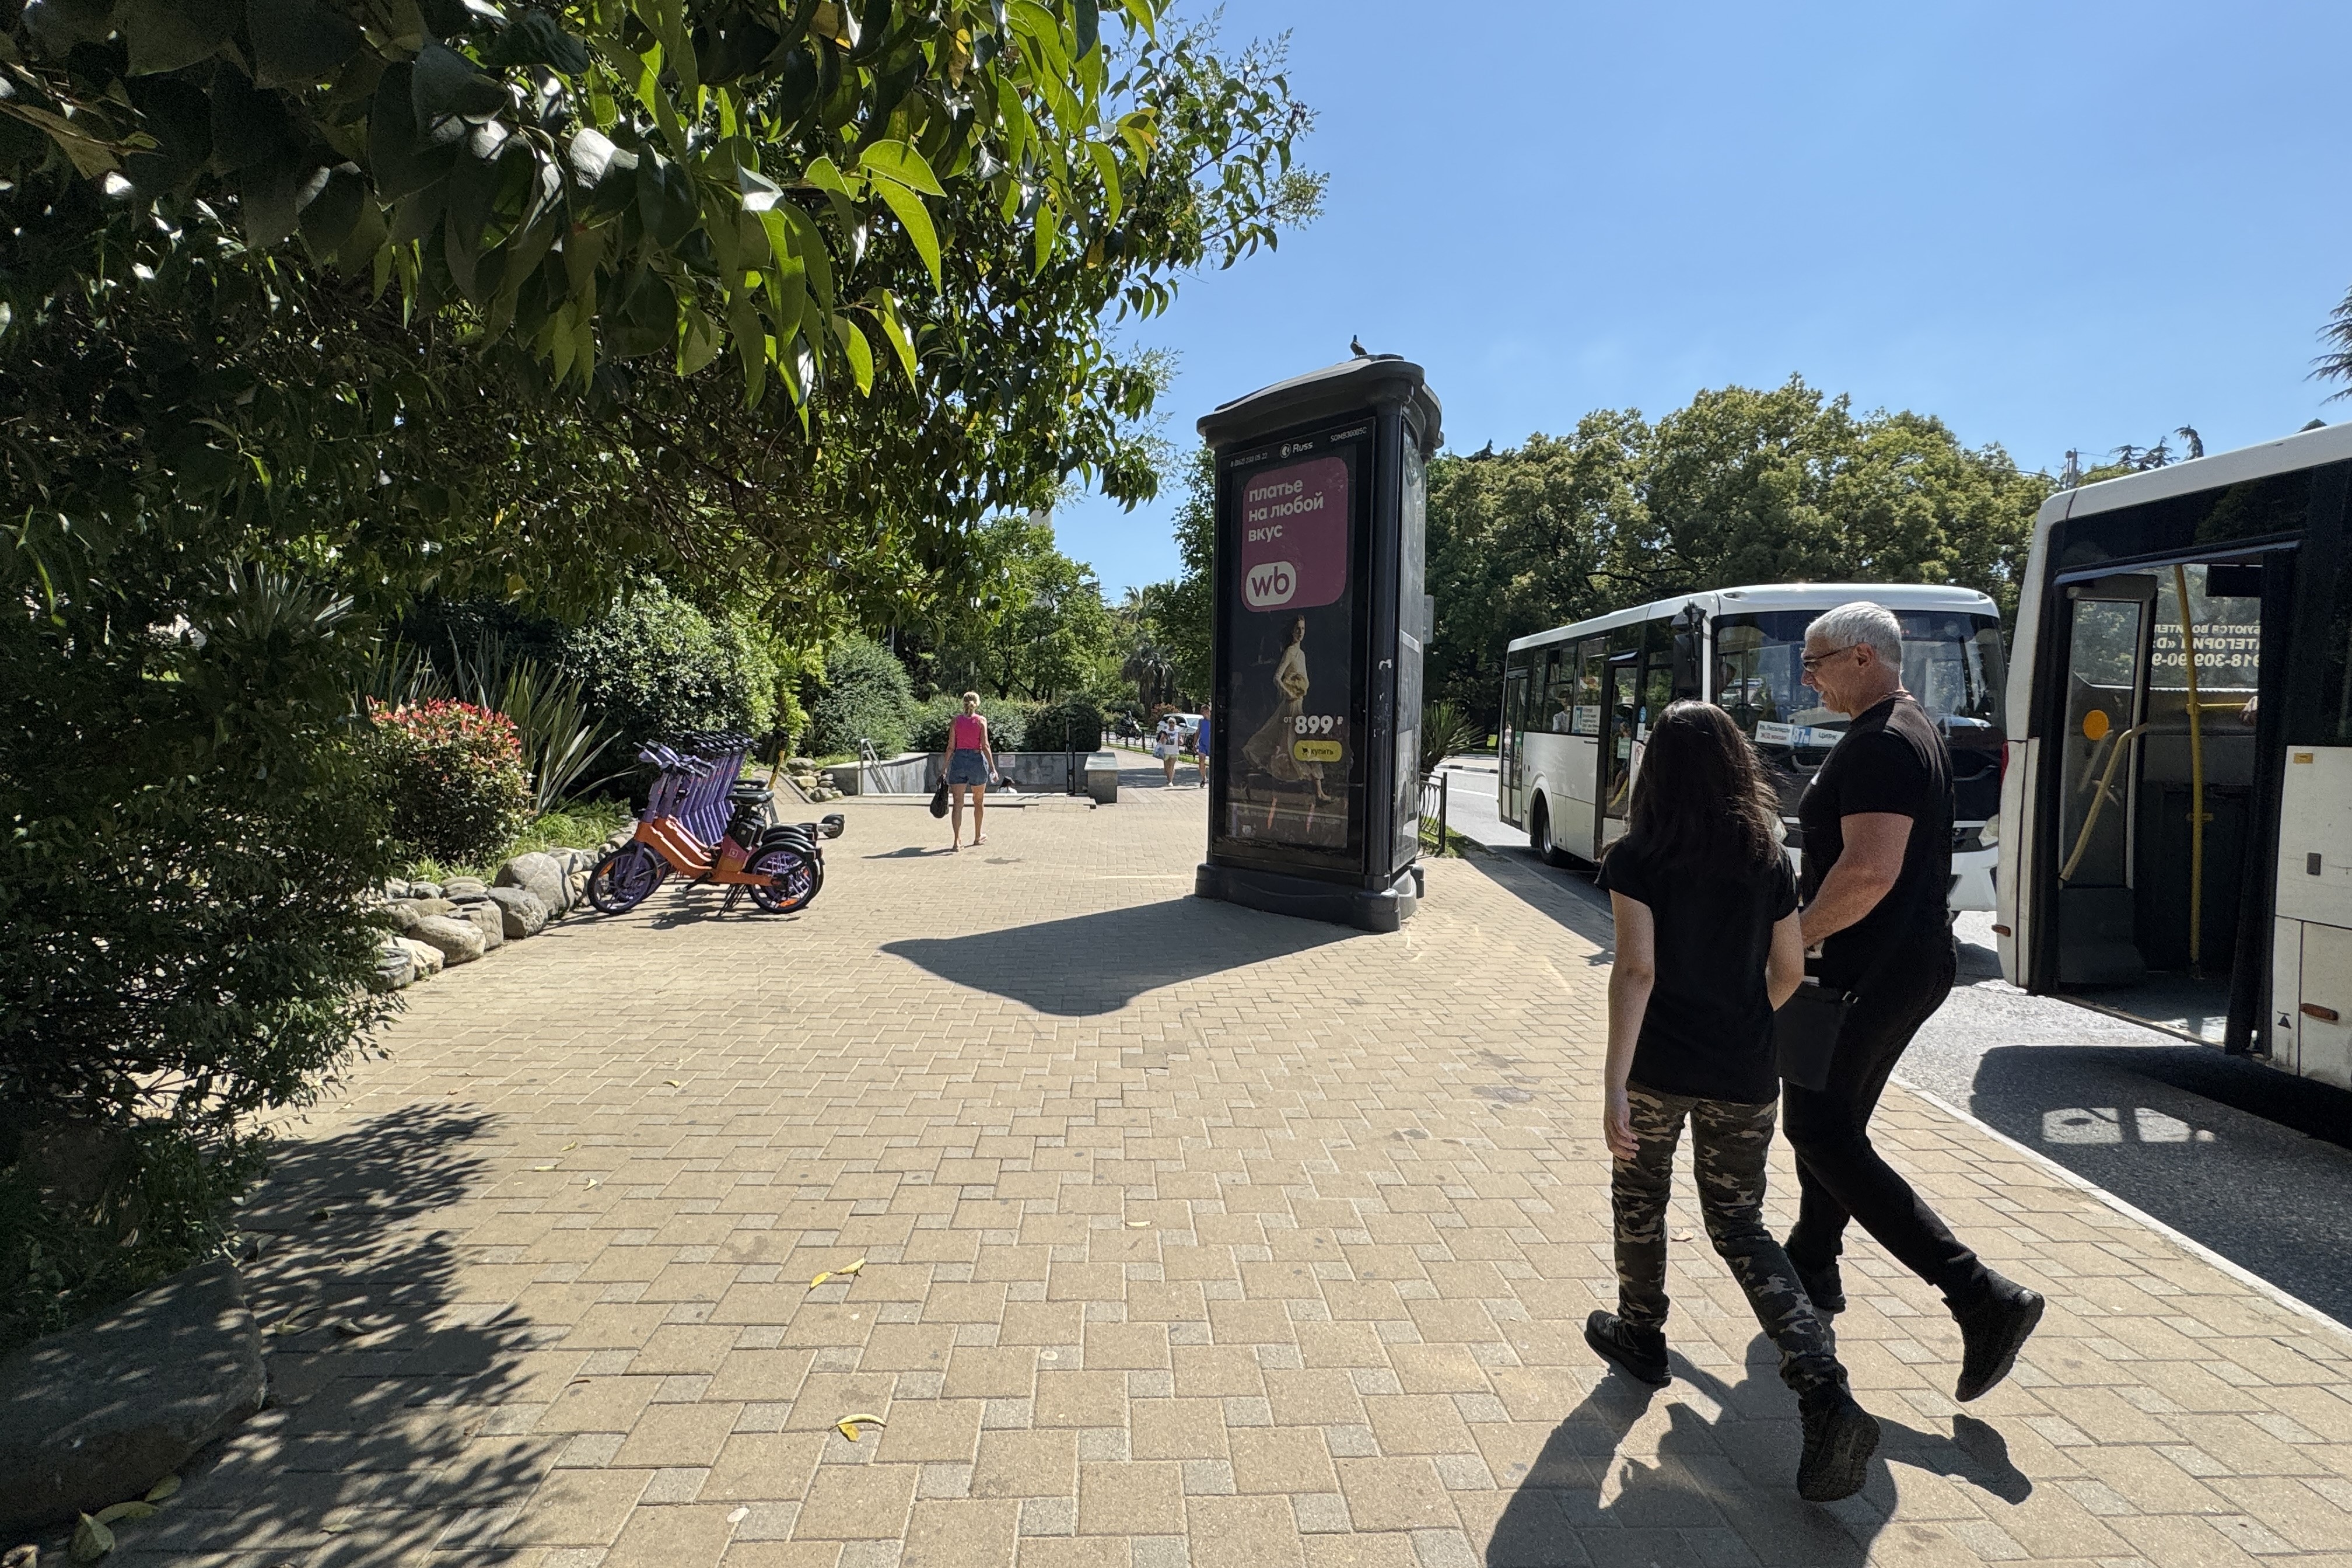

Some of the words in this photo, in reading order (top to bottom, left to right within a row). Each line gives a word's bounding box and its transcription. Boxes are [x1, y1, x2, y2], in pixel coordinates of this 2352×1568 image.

[1292, 442, 1313, 453] Russ
[1249, 480, 1303, 502] платье
[1248, 507, 1268, 522] на
[1270, 491, 1324, 518] любой
[1248, 524, 1283, 542] вкус
[1251, 566, 1290, 597] wb
[1294, 715, 1334, 734] 899
